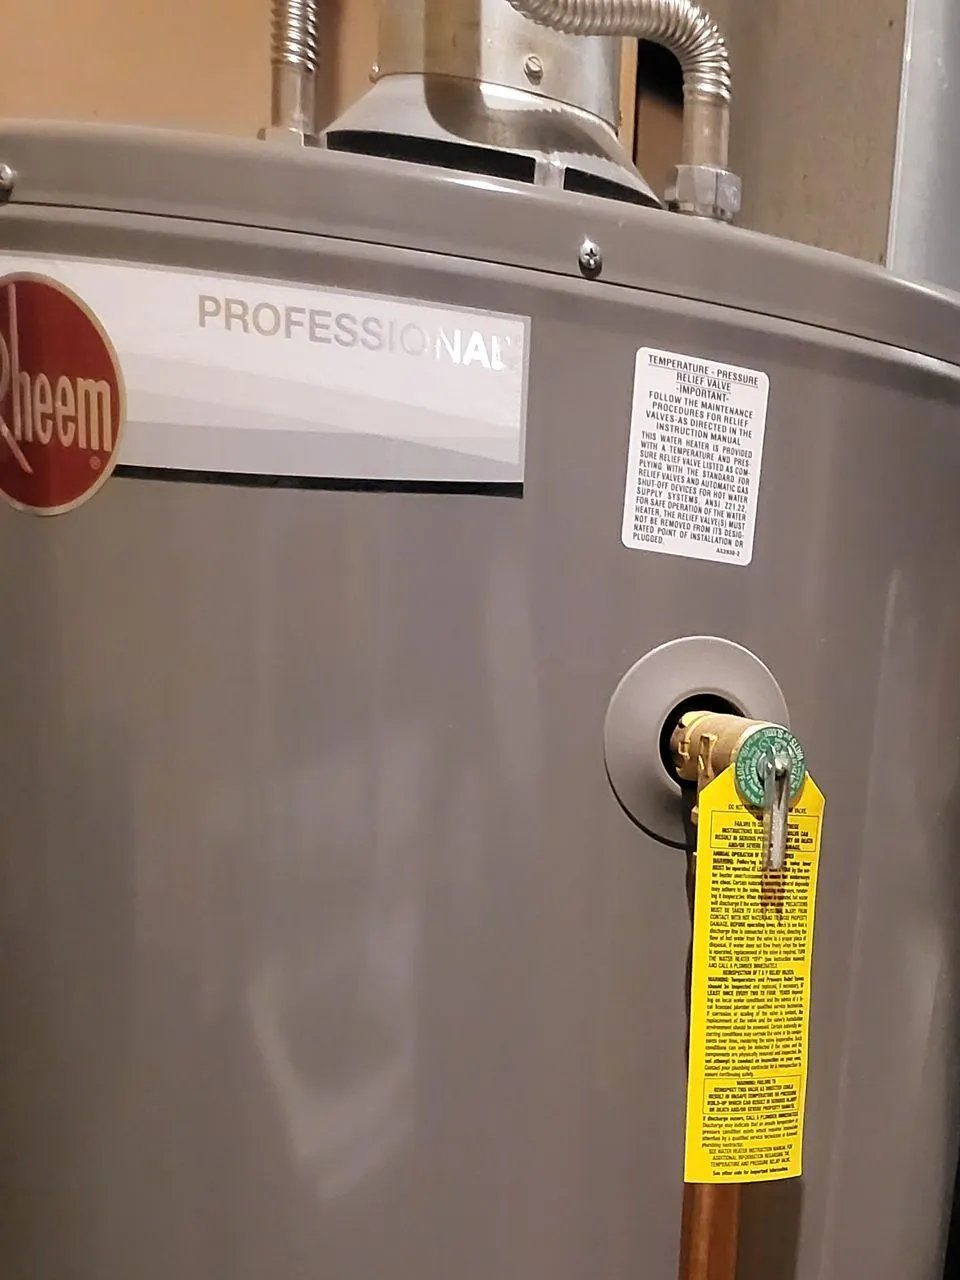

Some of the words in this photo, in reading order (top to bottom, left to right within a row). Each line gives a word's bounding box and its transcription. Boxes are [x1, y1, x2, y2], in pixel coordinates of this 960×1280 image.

[649, 355, 709, 375] TEMPERATURE
[717, 369, 759, 386] PRESSURE
[676, 372, 704, 386] RELIEF
[707, 378, 731, 391] VALVE
[649, 391, 682, 405] FOLLOW
[684, 398, 698, 408] THE
[701, 401, 753, 419] MAINTENANCE
[652, 401, 704, 419] PROCEDURES
[707, 412, 722, 423] FOR
[724, 415, 749, 428] RELIEF
[656, 422, 708, 440] INSTRUCTION
[711, 433, 741, 446] MANUAL
[690, 419, 727, 434] DIRECTED
[729, 427, 737, 436] IN
[739, 428, 752, 438] THE
[641, 441, 657, 451] WITH
[670, 446, 714, 461] TEMPERATURE
[718, 455, 730, 464] AND
[642, 431, 656, 441] THIS
[660, 435, 683, 446] WATER
[686, 440, 709, 451] HEATER
[723, 446, 753, 459] PROVIDED
[639, 459, 662, 470] PLYING
[666, 464, 683, 474] WITH
[687, 468, 698, 477] THE
[702, 471, 735, 483] STANDARD
[738, 477, 749, 486] FOR
[640, 450, 657, 460] SURE
[659, 454, 680, 464] RELIEF
[683, 458, 701, 468] VALVE
[703, 462, 724, 472] LISTED
[726, 466, 733, 474] AS
[638, 478, 668, 490] SHUT-OFF
[671, 484, 697, 495] DEVICES
[699, 489, 711, 497] FOR
[713, 491, 726, 500] HOT
[728, 494, 748, 504] WATER
[639, 469, 660, 479] RELIEF
[662, 473, 684, 483] VALVES
[686, 477, 699, 486] AND
[701, 480, 735, 493] AUTOMATIC
[737, 486, 748, 495] GAS
[636, 496, 649, 505] FOR
[650, 499, 665, 508] SAFE
[668, 502, 702, 514] OPERATION
[704, 508, 712, 516] OF
[713, 509, 724, 518] THE
[726, 512, 746, 522] WATER
[637, 487, 662, 498] SUPPLY
[705, 499, 720, 508] ANSI
[635, 515, 647, 523] NOT
[650, 517, 658, 525] BE
[661, 519, 691, 531] REMOVED
[693, 525, 710, 534] FROM
[713, 528, 722, 536] ITS
[724, 530, 744, 540] DESIG-
[664, 510, 675, 519] THE
[678, 513, 697, 523] RELIEF
[728, 521, 745, 531] MUST
[634, 524, 654, 534] NATED
[657, 528, 676, 537] POINT
[680, 531, 687, 539] OF
[690, 533, 732, 547] INSTALLATION
[735, 540, 743, 549] OR
